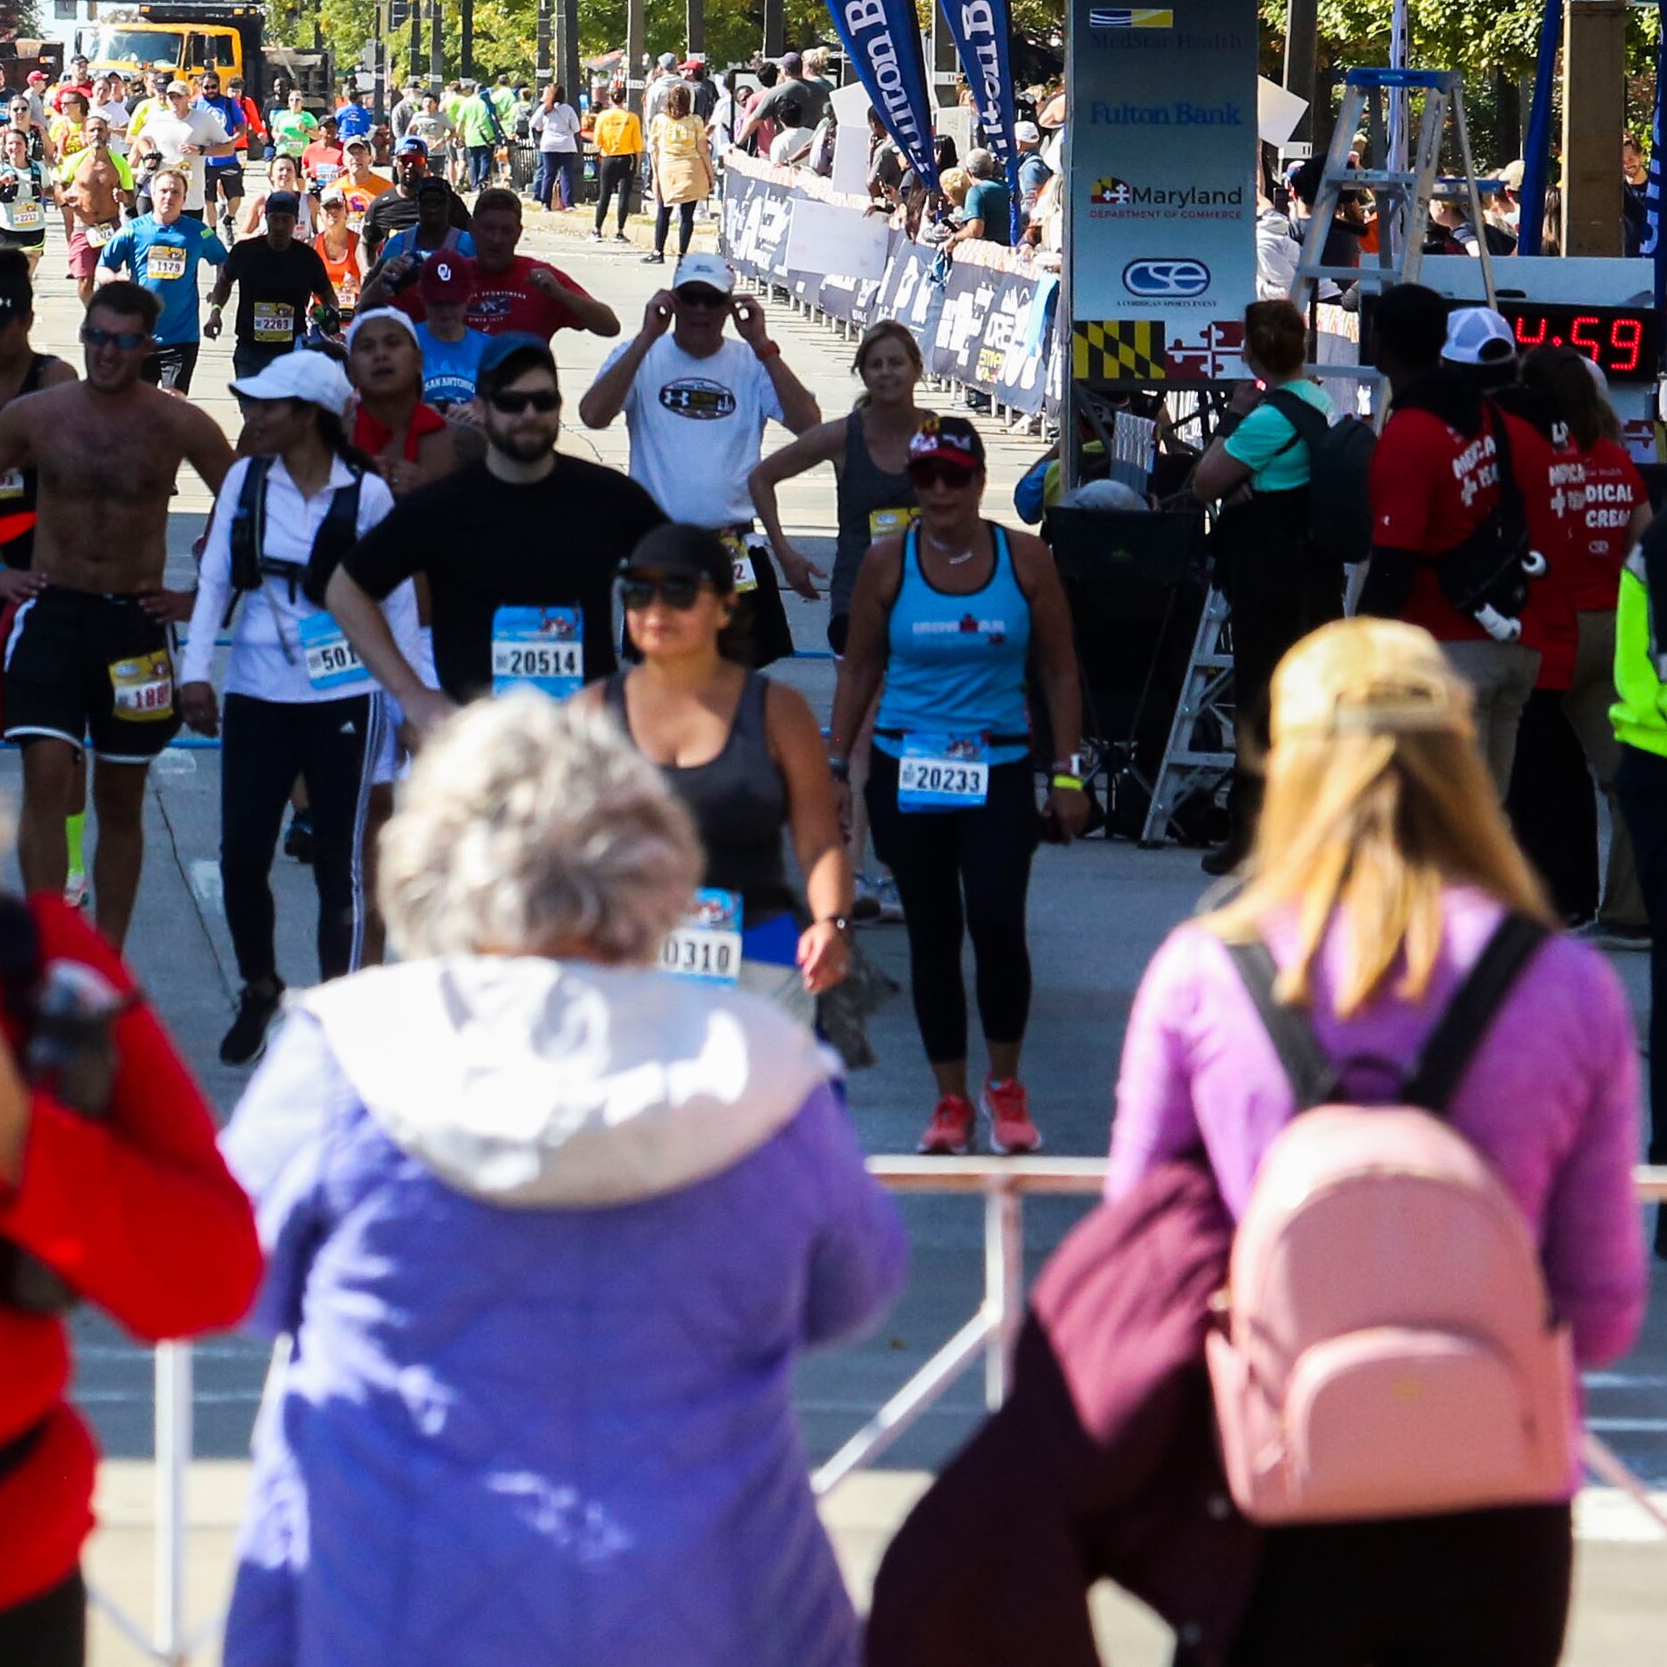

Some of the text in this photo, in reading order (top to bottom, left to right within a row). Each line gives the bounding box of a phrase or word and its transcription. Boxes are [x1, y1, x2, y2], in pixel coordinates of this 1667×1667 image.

[1090, 100, 1244, 126] Fulton Bank
[1131, 185, 1243, 209] Maryland
[1088, 209, 1243, 221] DEPARTMENT OF COMMERCE
[424, 376, 441, 393] SAN
[510, 649, 577, 675] 20514
[916, 765, 980, 793] 20233
